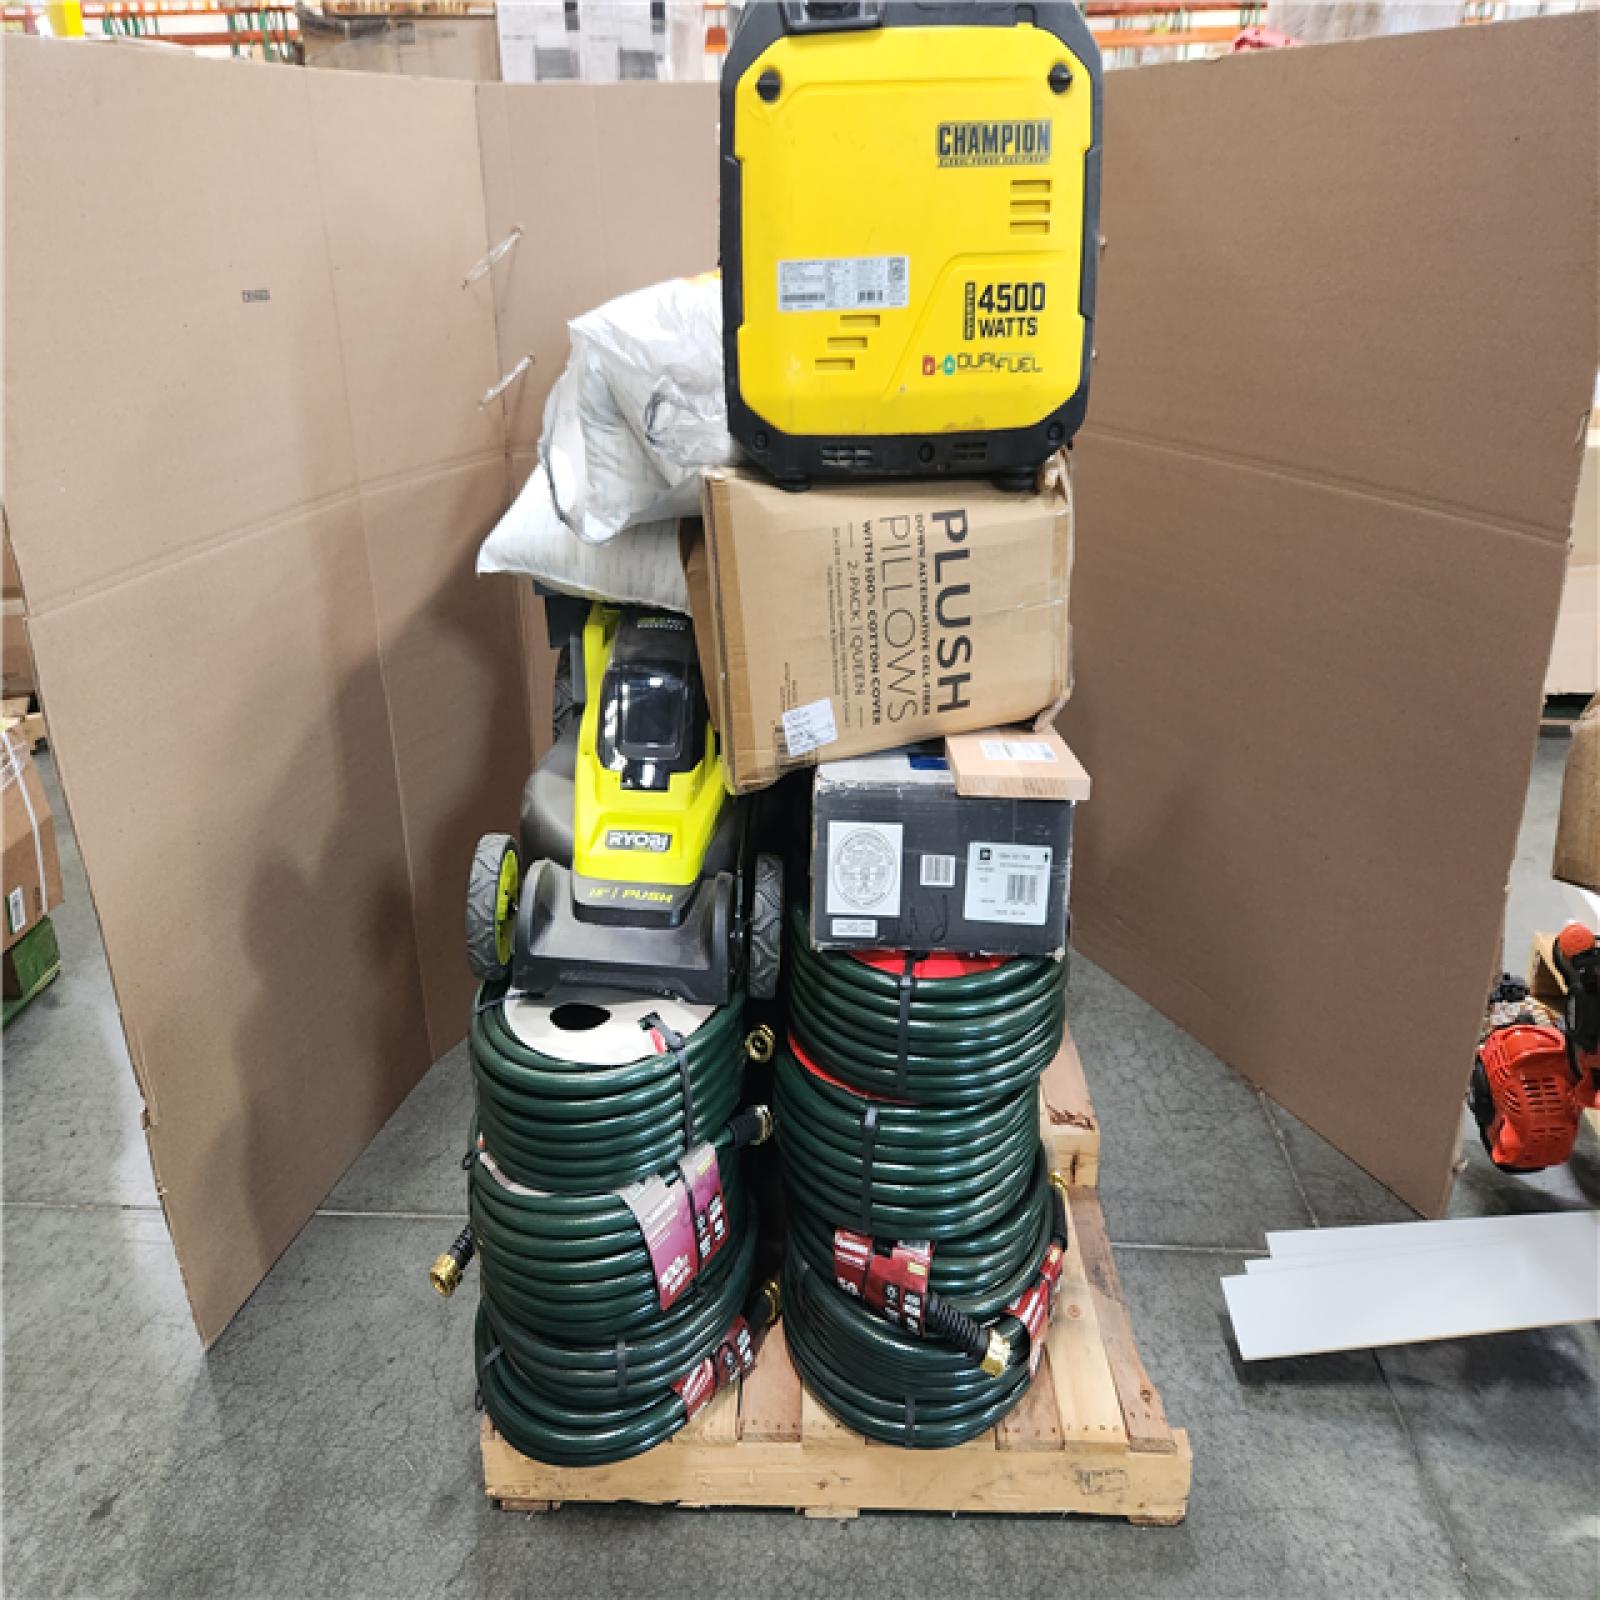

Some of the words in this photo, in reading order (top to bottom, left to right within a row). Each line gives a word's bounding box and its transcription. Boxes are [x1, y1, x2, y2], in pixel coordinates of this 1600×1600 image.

[939, 122, 1050, 156] CHAMPION
[978, 282, 1045, 313] 4500
[979, 317, 1038, 338] WATTS
[863, 519, 873, 562] WITH
[914, 512, 925, 557] DOWN
[847, 559, 861, 623] 2-PACK
[919, 562, 930, 650] ALTERNATIVE
[932, 508, 971, 712] PLUSH
[867, 609, 880, 673] COTTON
[880, 514, 917, 722] PILLOWS
[850, 634, 866, 696] QUEEN
[871, 677, 882, 726] COVER
[608, 831, 669, 852] RYOBI
[622, 889, 673, 904] PUSH
